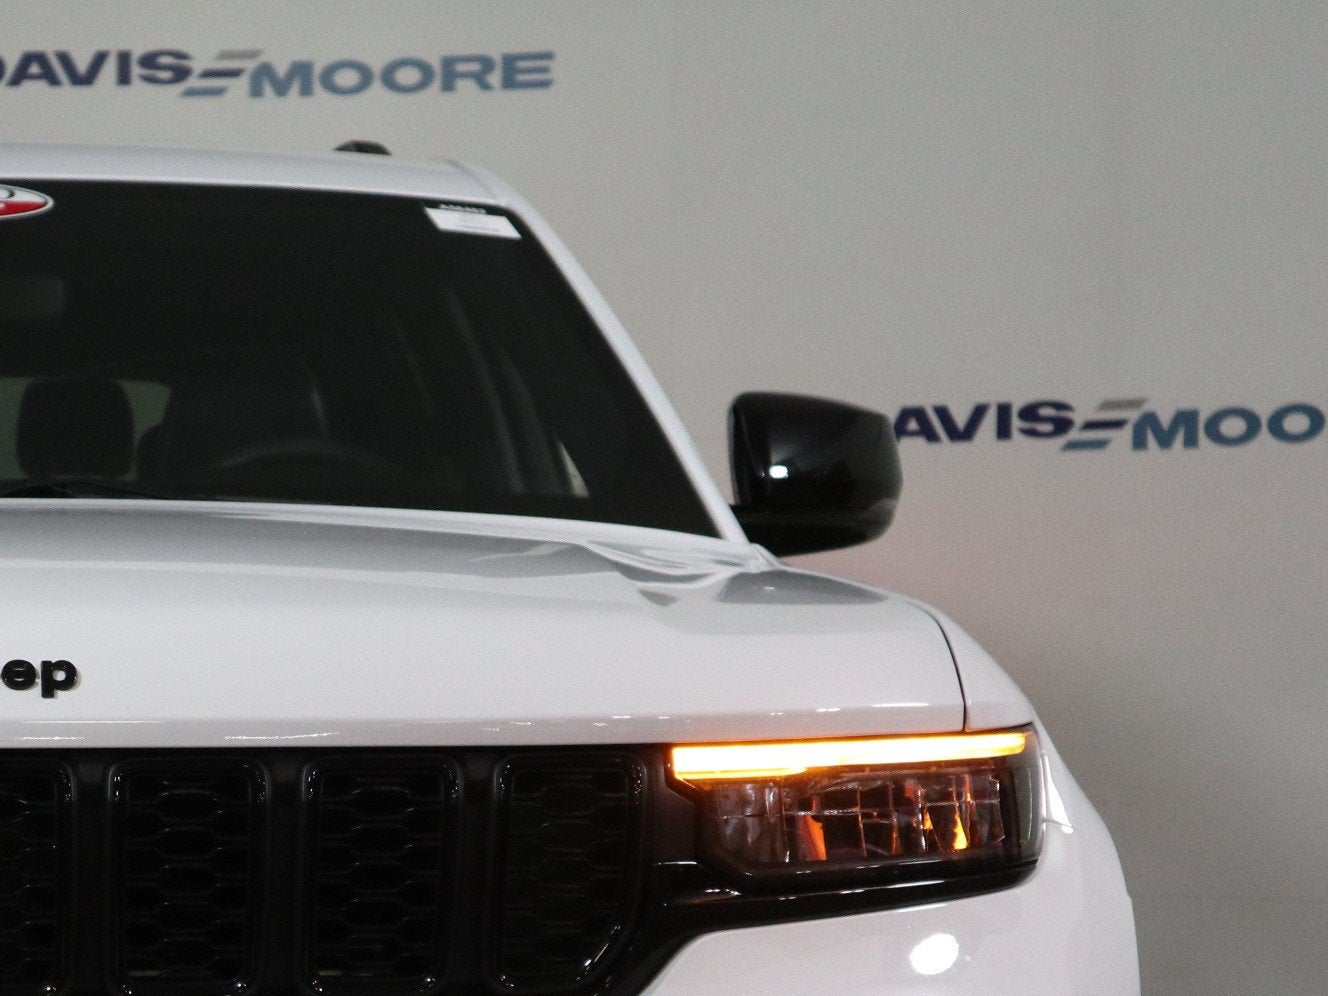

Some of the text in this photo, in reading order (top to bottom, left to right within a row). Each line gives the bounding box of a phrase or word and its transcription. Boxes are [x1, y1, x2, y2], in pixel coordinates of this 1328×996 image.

[248, 51, 556, 98] MOORE
[894, 399, 1327, 452] AVIS MOO
